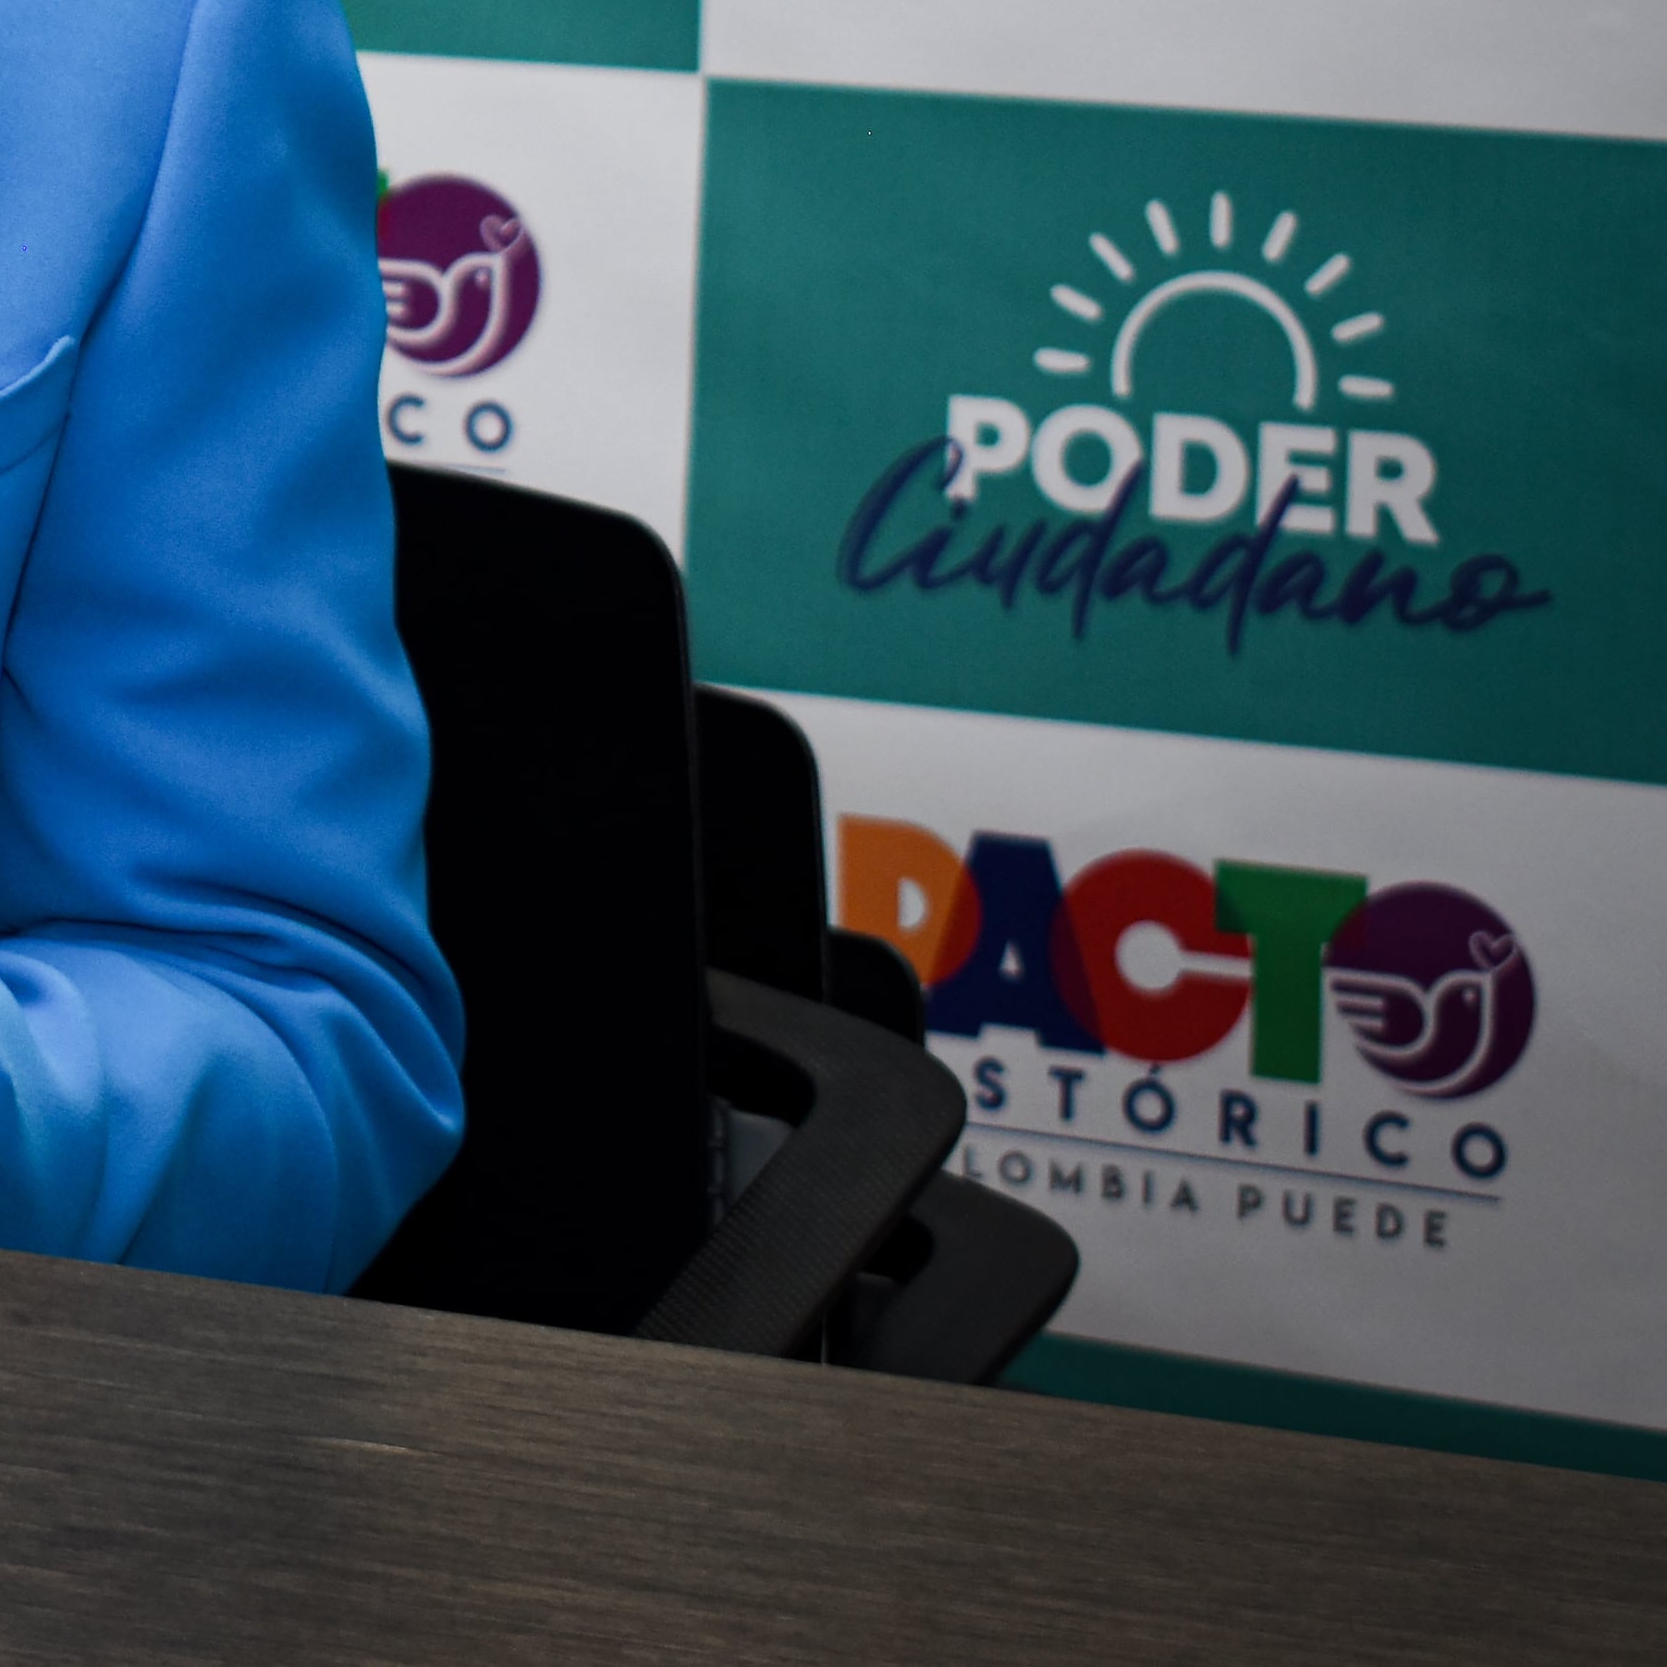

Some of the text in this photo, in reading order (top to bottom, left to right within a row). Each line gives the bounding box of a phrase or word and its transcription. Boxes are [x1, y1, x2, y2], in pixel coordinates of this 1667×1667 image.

[944, 394, 1439, 546] PODER
[836, 435, 1551, 658] Ciudadano
[838, 813, 1535, 1100] PACTO
[973, 1057, 1507, 1180] STÓRICO
[964, 1145, 1448, 1248] LOMBIA PUEDE
